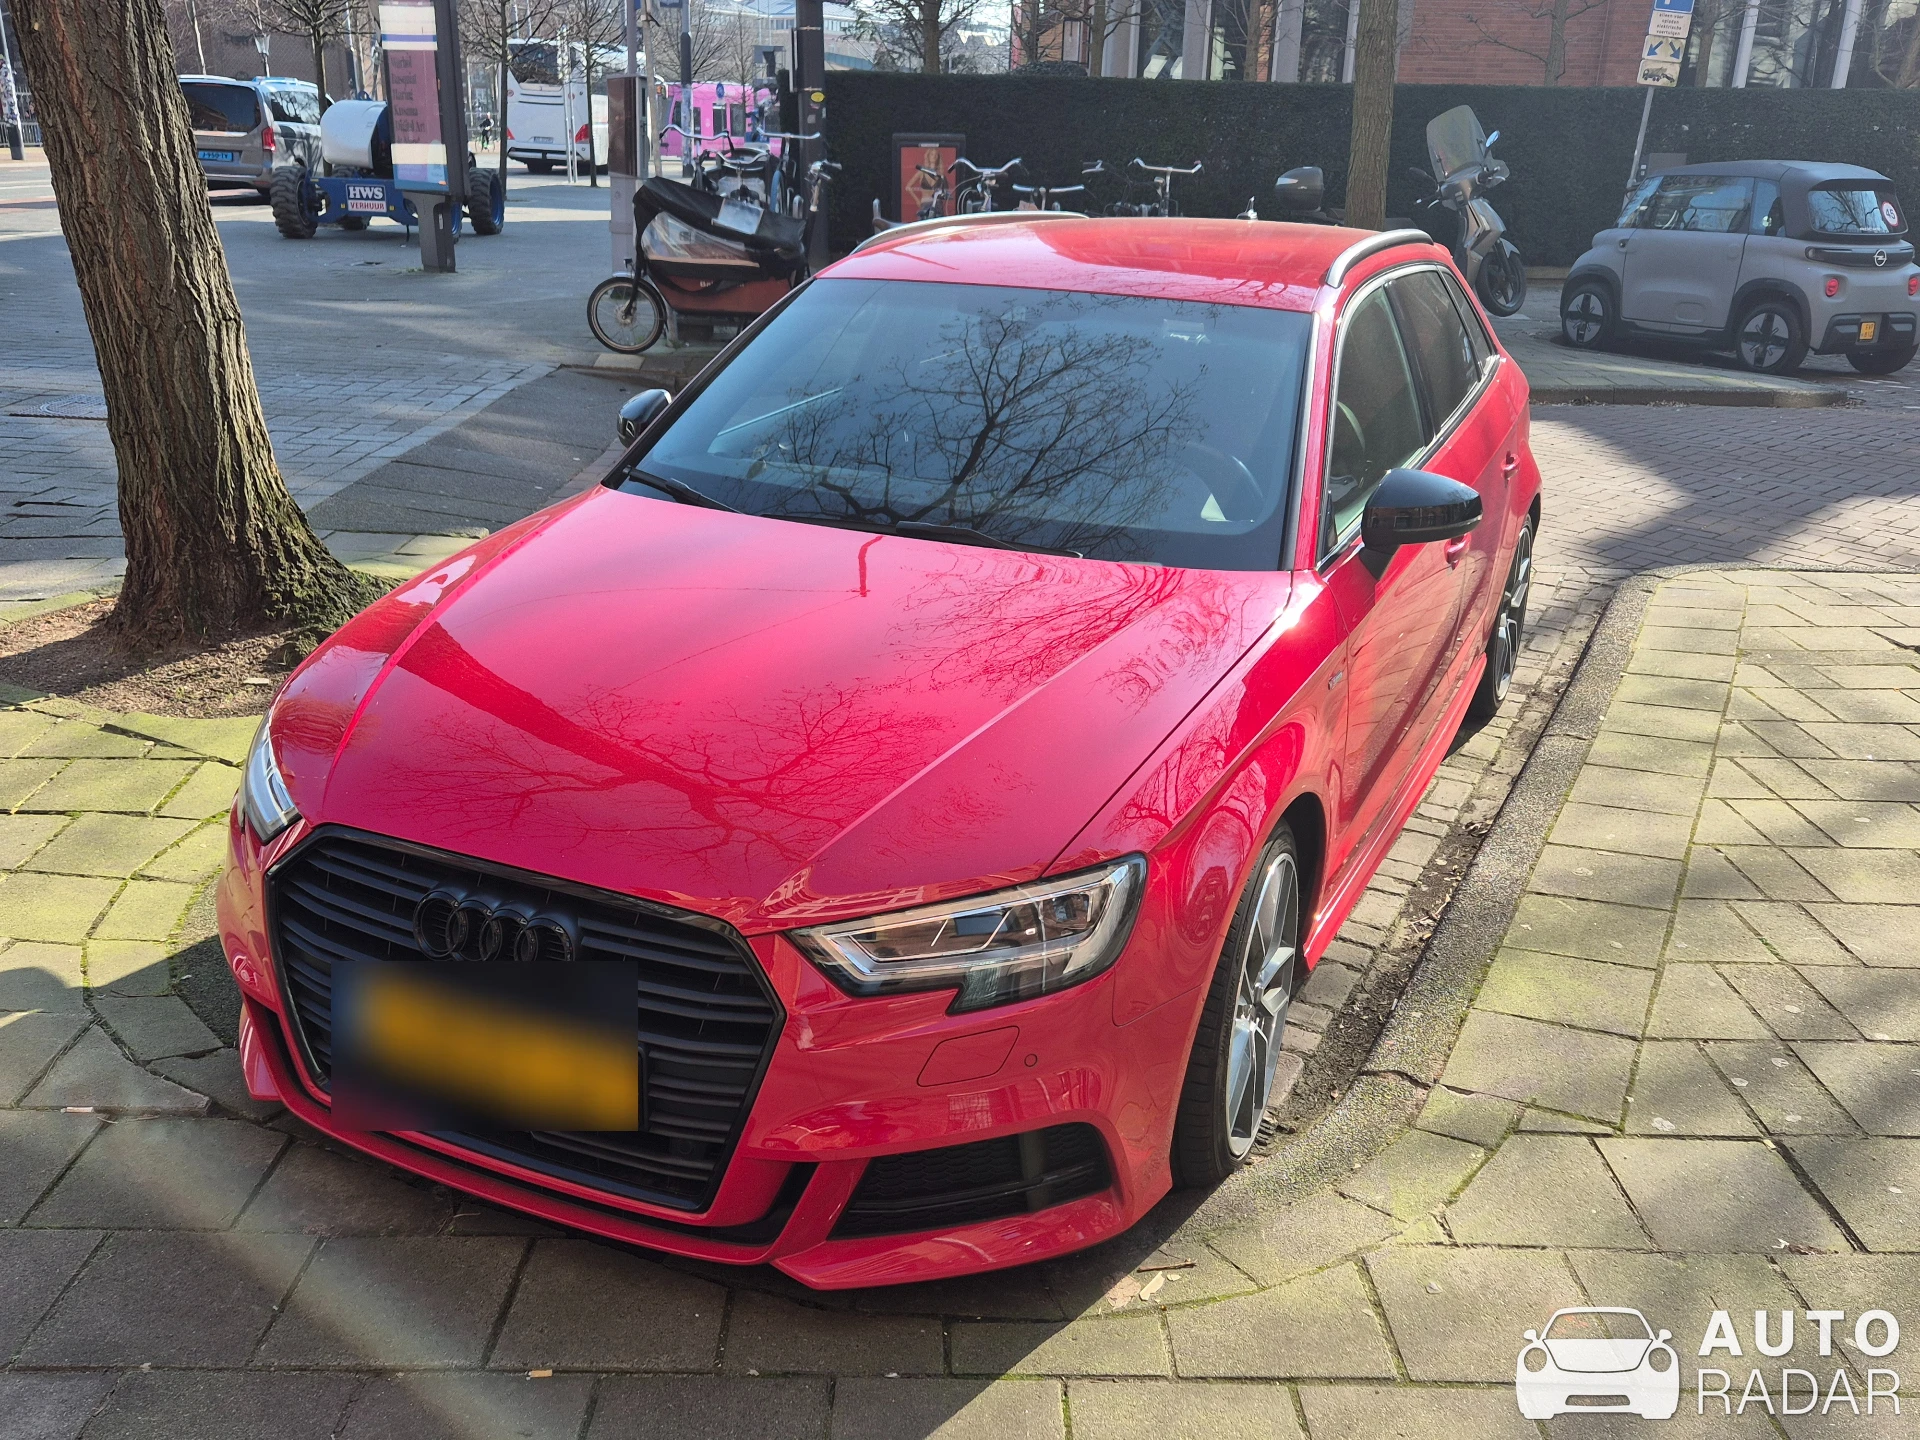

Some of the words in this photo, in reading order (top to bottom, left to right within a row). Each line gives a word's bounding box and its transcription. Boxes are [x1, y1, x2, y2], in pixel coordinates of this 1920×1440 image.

[348, 186, 384, 199] HWS
[350, 201, 385, 210] VERHUUR
[1885, 208, 1896, 220] 45
